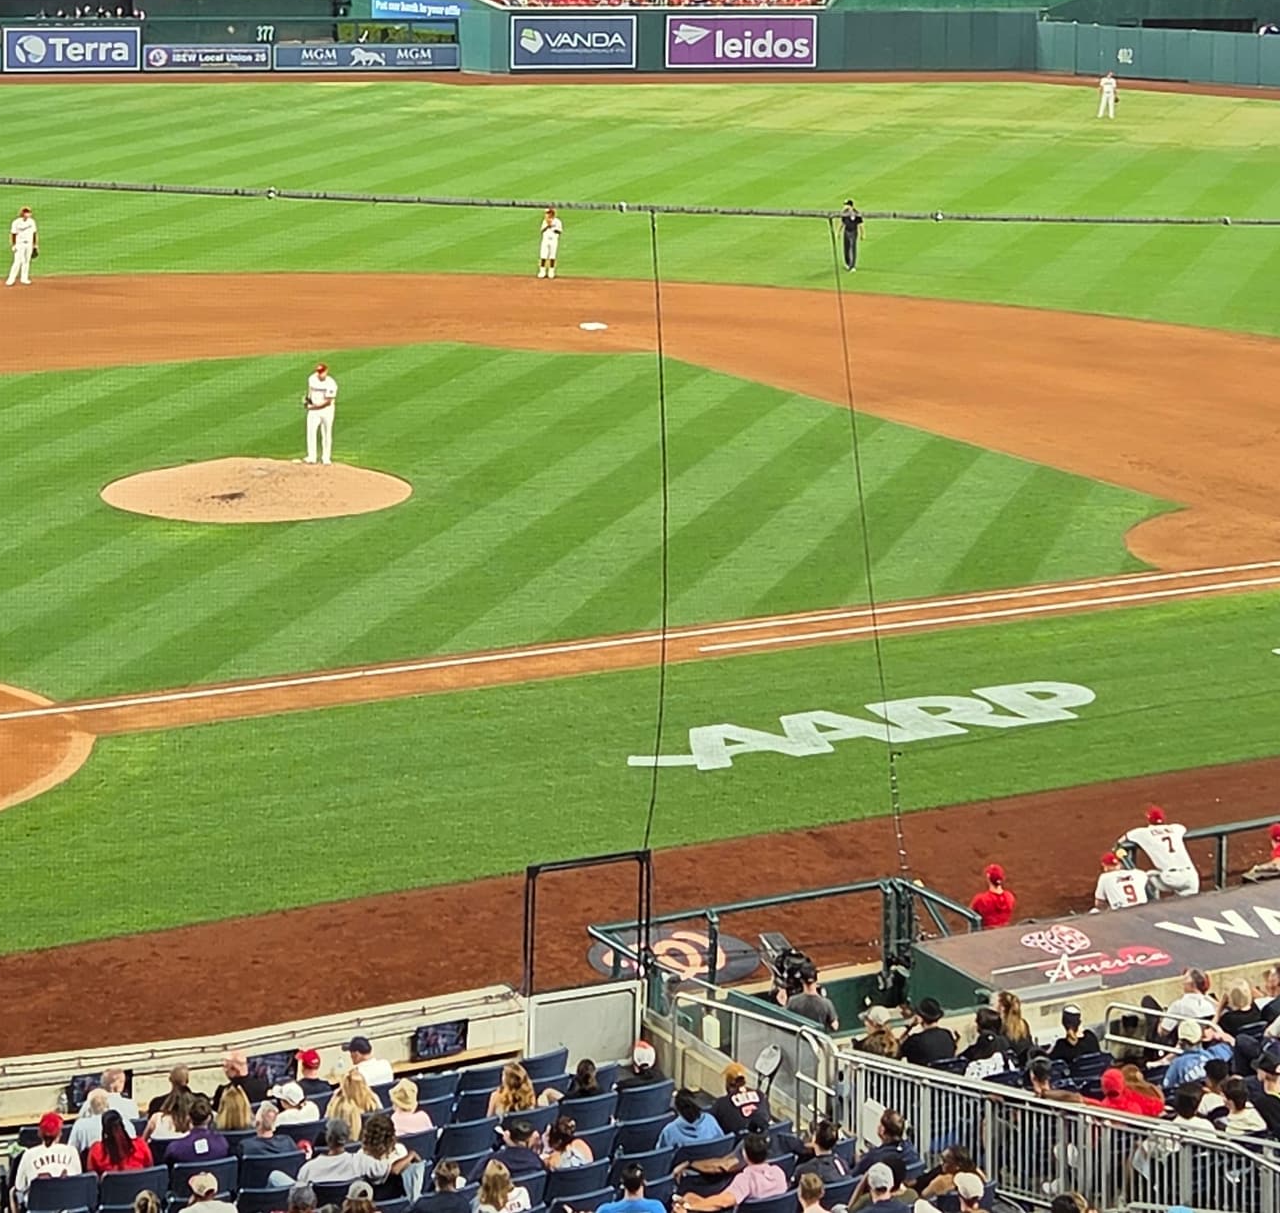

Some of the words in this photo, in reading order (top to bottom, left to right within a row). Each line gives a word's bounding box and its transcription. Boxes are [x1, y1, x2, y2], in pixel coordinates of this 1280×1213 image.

[256, 26, 274, 41] 377
[545, 32, 626, 49] VANDA
[49, 36, 129, 63] Terra
[715, 28, 809, 59] leidos
[172, 53, 197, 63] IBEW
[199, 53, 224, 63] Local
[225, 53, 251, 63] Union
[301, 49, 336, 60] MGM
[396, 48, 432, 59] MGM
[628, 681, 1096, 770] AARP
[1162, 837, 1175, 853] 7
[1123, 884, 1137, 904] 9
[1047, 946, 1173, 984] America
[33, 1155, 72, 1171] CAVALLI
